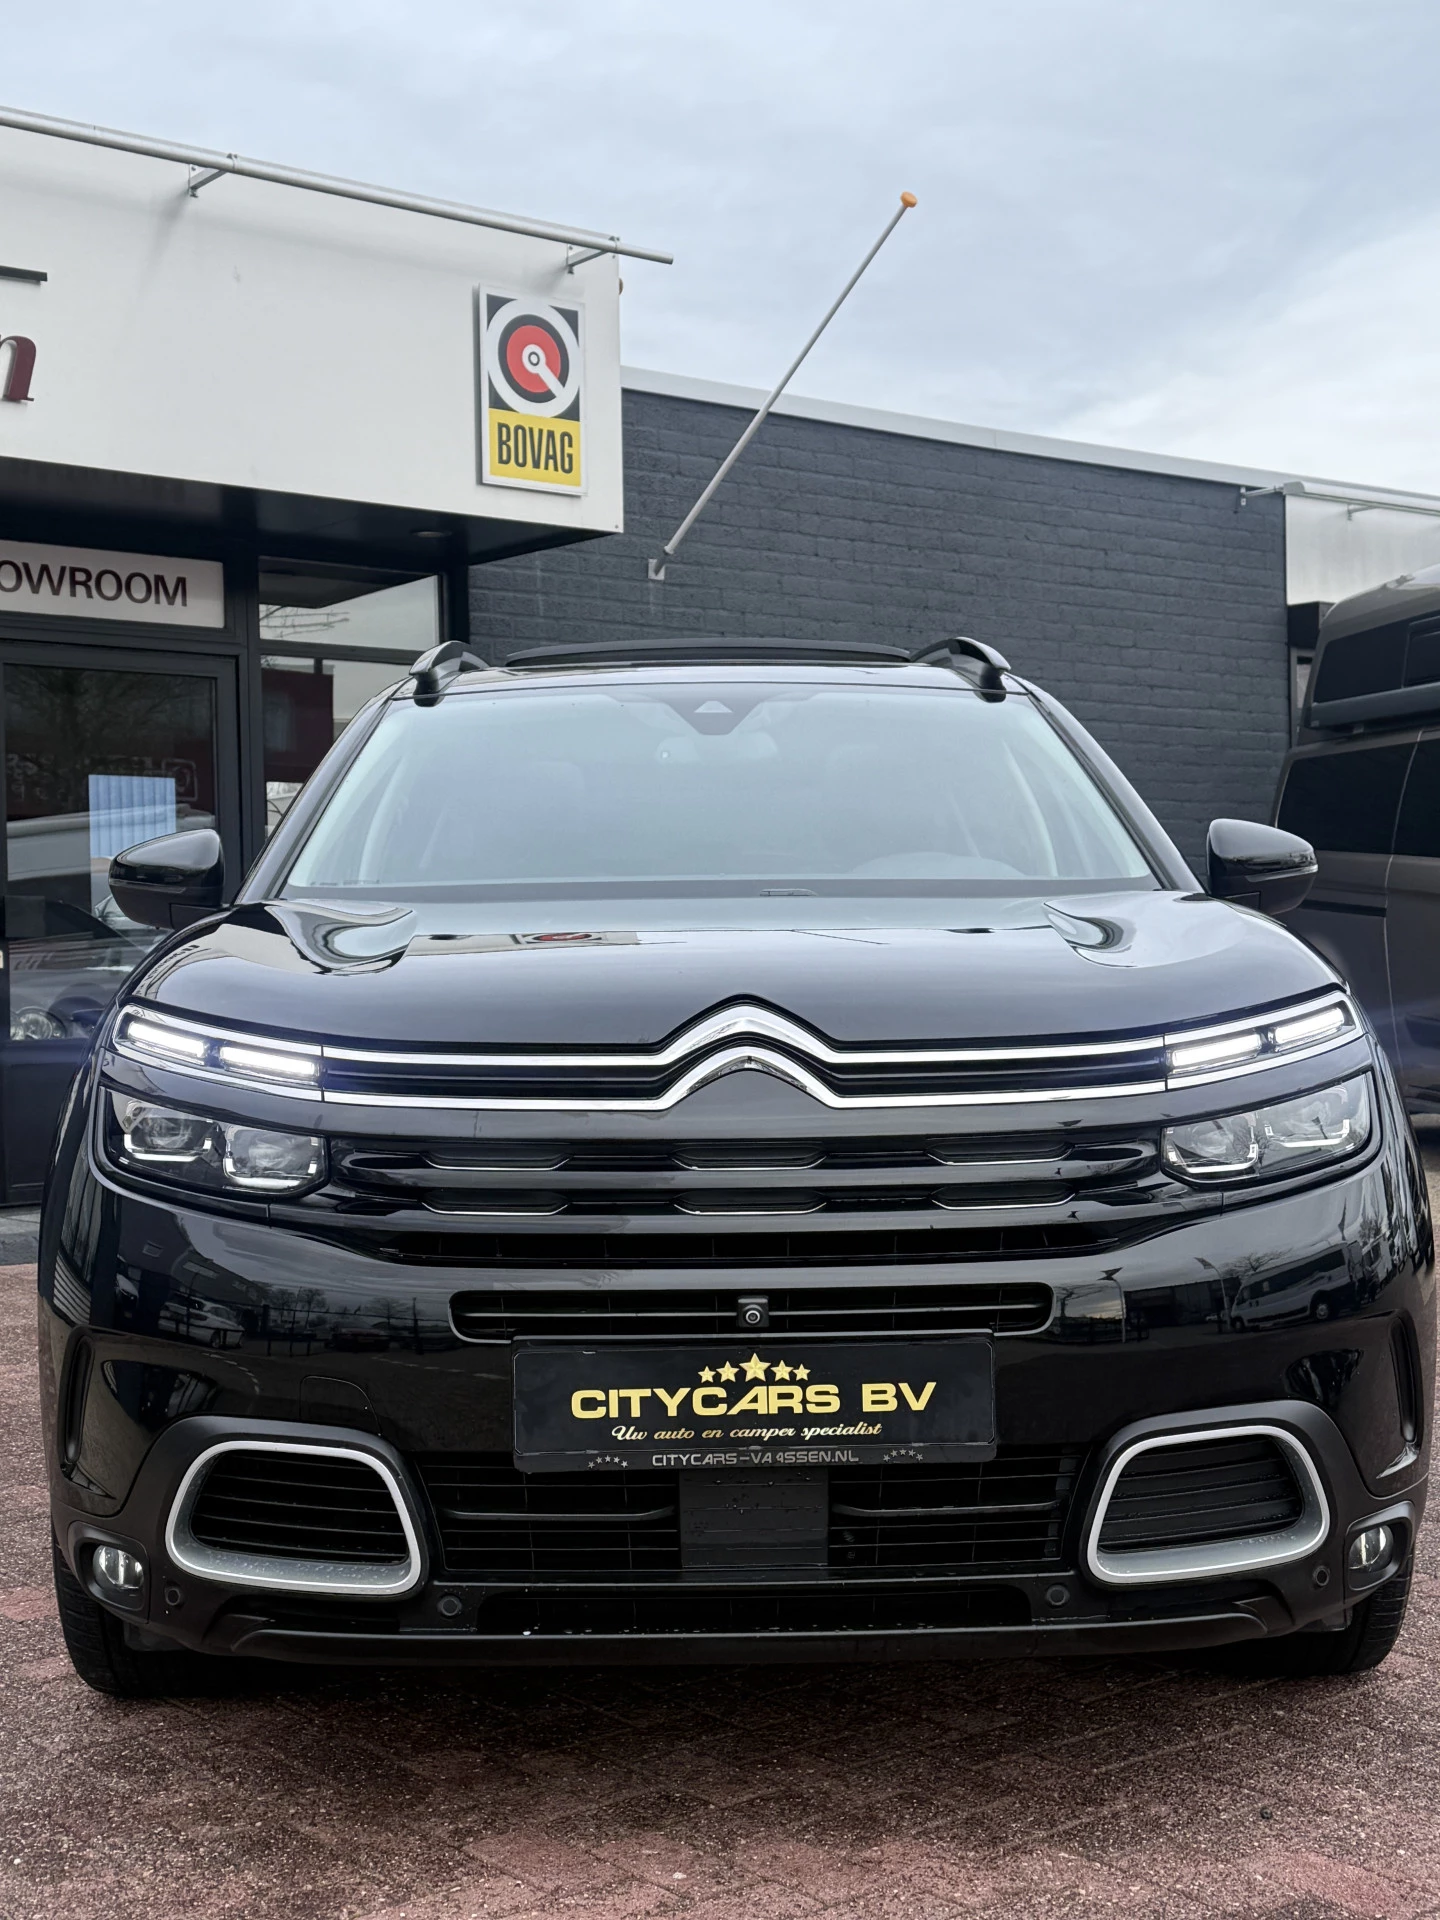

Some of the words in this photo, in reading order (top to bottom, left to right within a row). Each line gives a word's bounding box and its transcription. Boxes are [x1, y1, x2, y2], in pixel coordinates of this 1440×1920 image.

[497, 422, 573, 474] BOVAG
[0, 560, 188, 607] OWROOM
[571, 1384, 841, 1419] CITYCARS
[862, 1381, 937, 1412] BV
[611, 1425, 648, 1440] Uw
[653, 1427, 695, 1440] auto
[701, 1428, 724, 1439] en
[729, 1427, 797, 1441] camper
[800, 1421, 883, 1441] specialist
